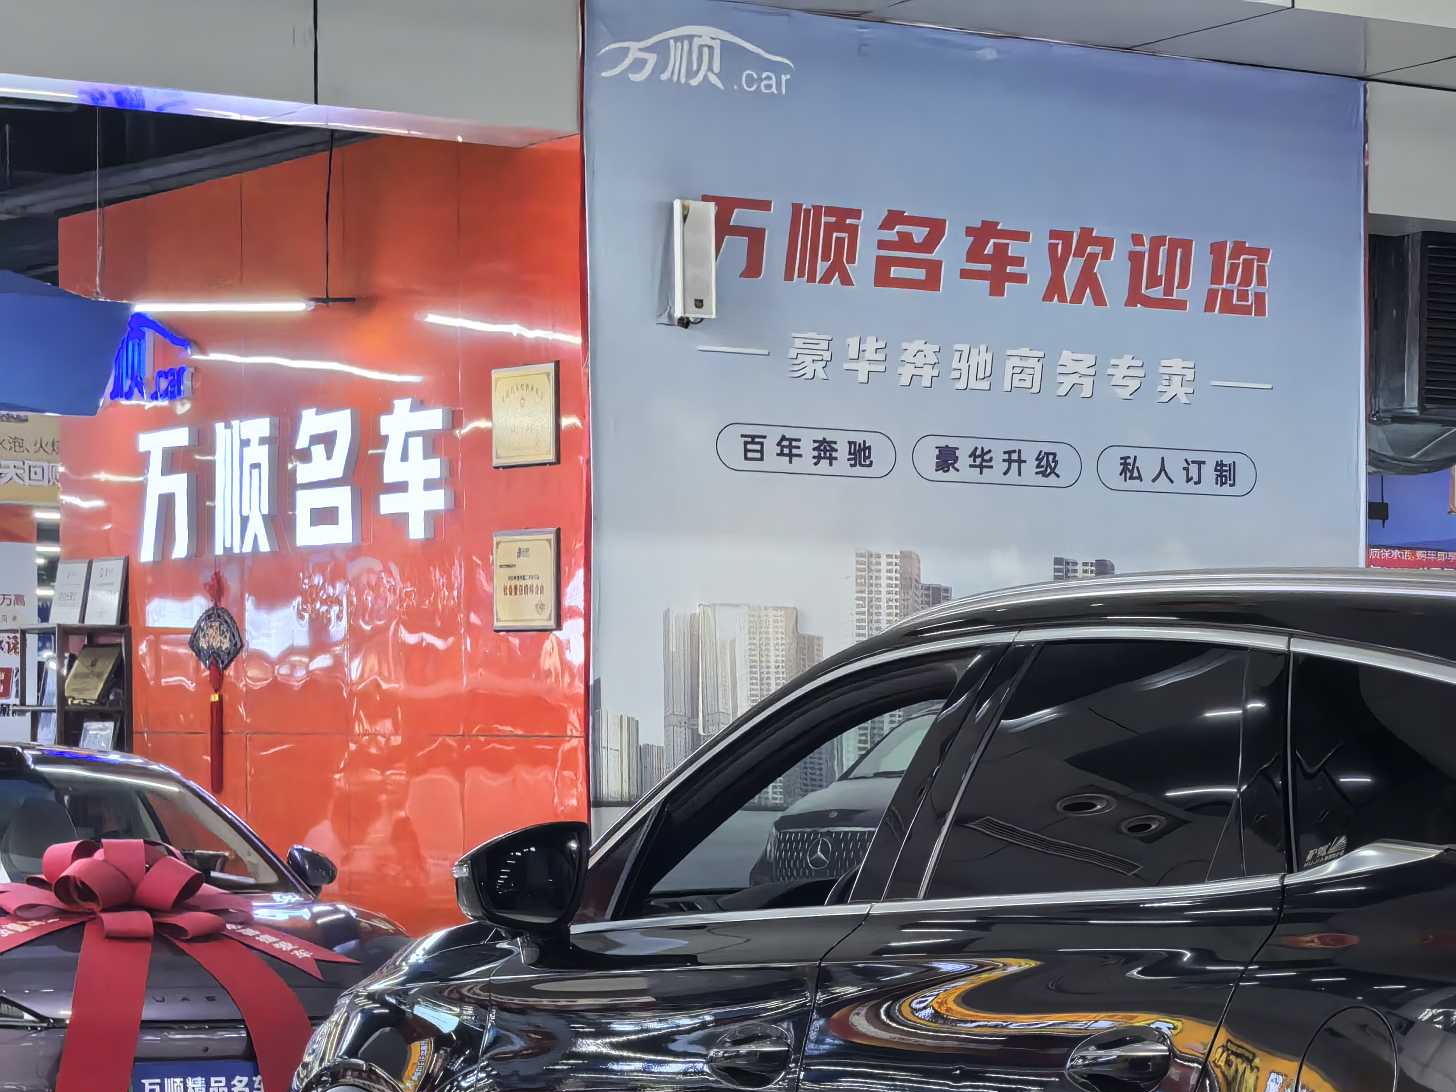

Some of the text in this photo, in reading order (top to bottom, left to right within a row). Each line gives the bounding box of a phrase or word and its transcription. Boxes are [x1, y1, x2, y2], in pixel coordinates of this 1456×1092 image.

[701, 194, 1273, 318] 万顺名车欢迎您
[787, 331, 1198, 404] 豪华奔驰商务专卖
[741, 433, 874, 469] 百年奔驰
[935, 444, 1062, 480] 豪华升级
[1118, 455, 1238, 489] 私人订制
[137, 398, 446, 563] 万顺名车
